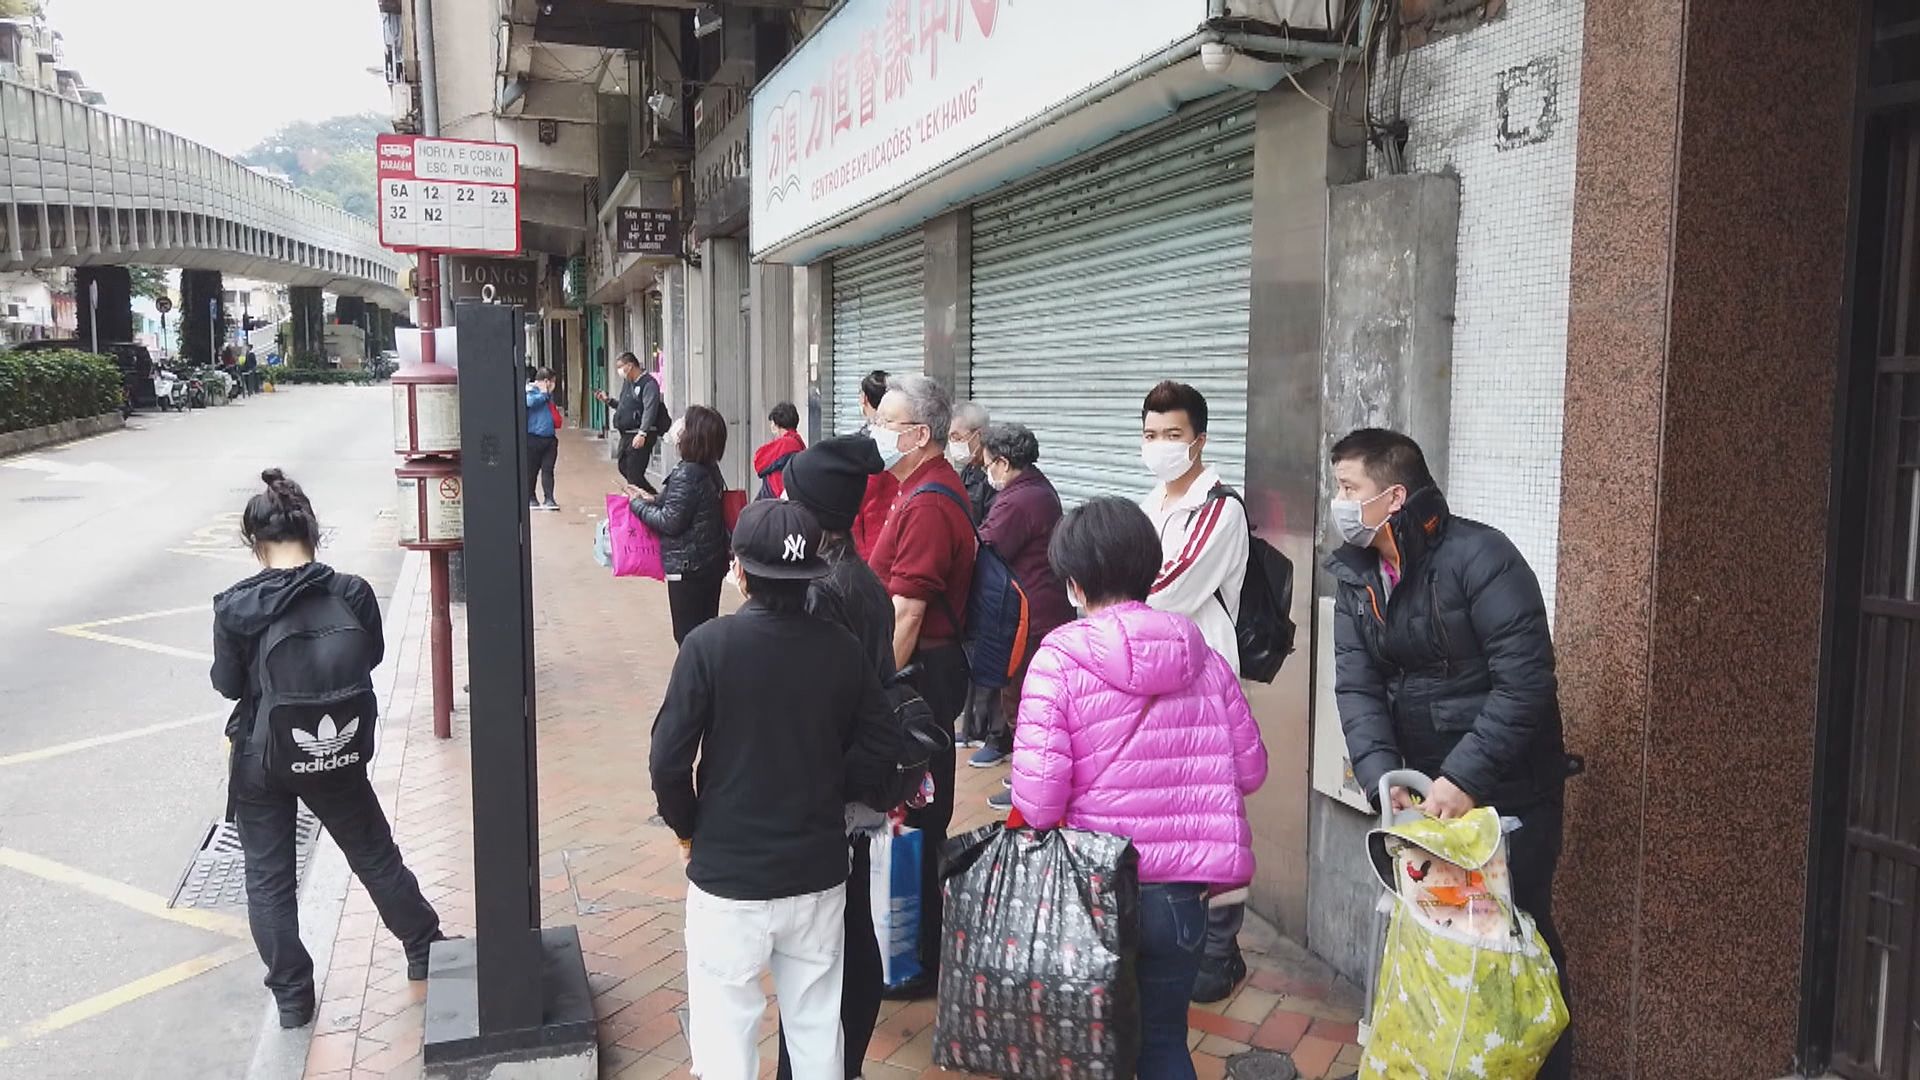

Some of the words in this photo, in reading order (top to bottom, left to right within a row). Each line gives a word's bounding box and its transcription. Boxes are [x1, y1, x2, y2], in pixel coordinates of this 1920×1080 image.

[419, 146, 454, 159] HORTA
[459, 148, 466, 159] E
[454, 164, 469, 176] PUI
[473, 166, 503, 178] CHING
[811, 168, 839, 201] CENTRO
[840, 161, 850, 187] DE
[391, 184, 408, 197] 6A
[423, 186, 439, 200] 12
[457, 188, 475, 201] 22
[491, 190, 508, 204] 23
[390, 206, 407, 219] 32
[424, 208, 442, 221] N2
[461, 264, 529, 285] LONGS
[782, 533, 806, 562] NY
[291, 752, 360, 773] adidas
